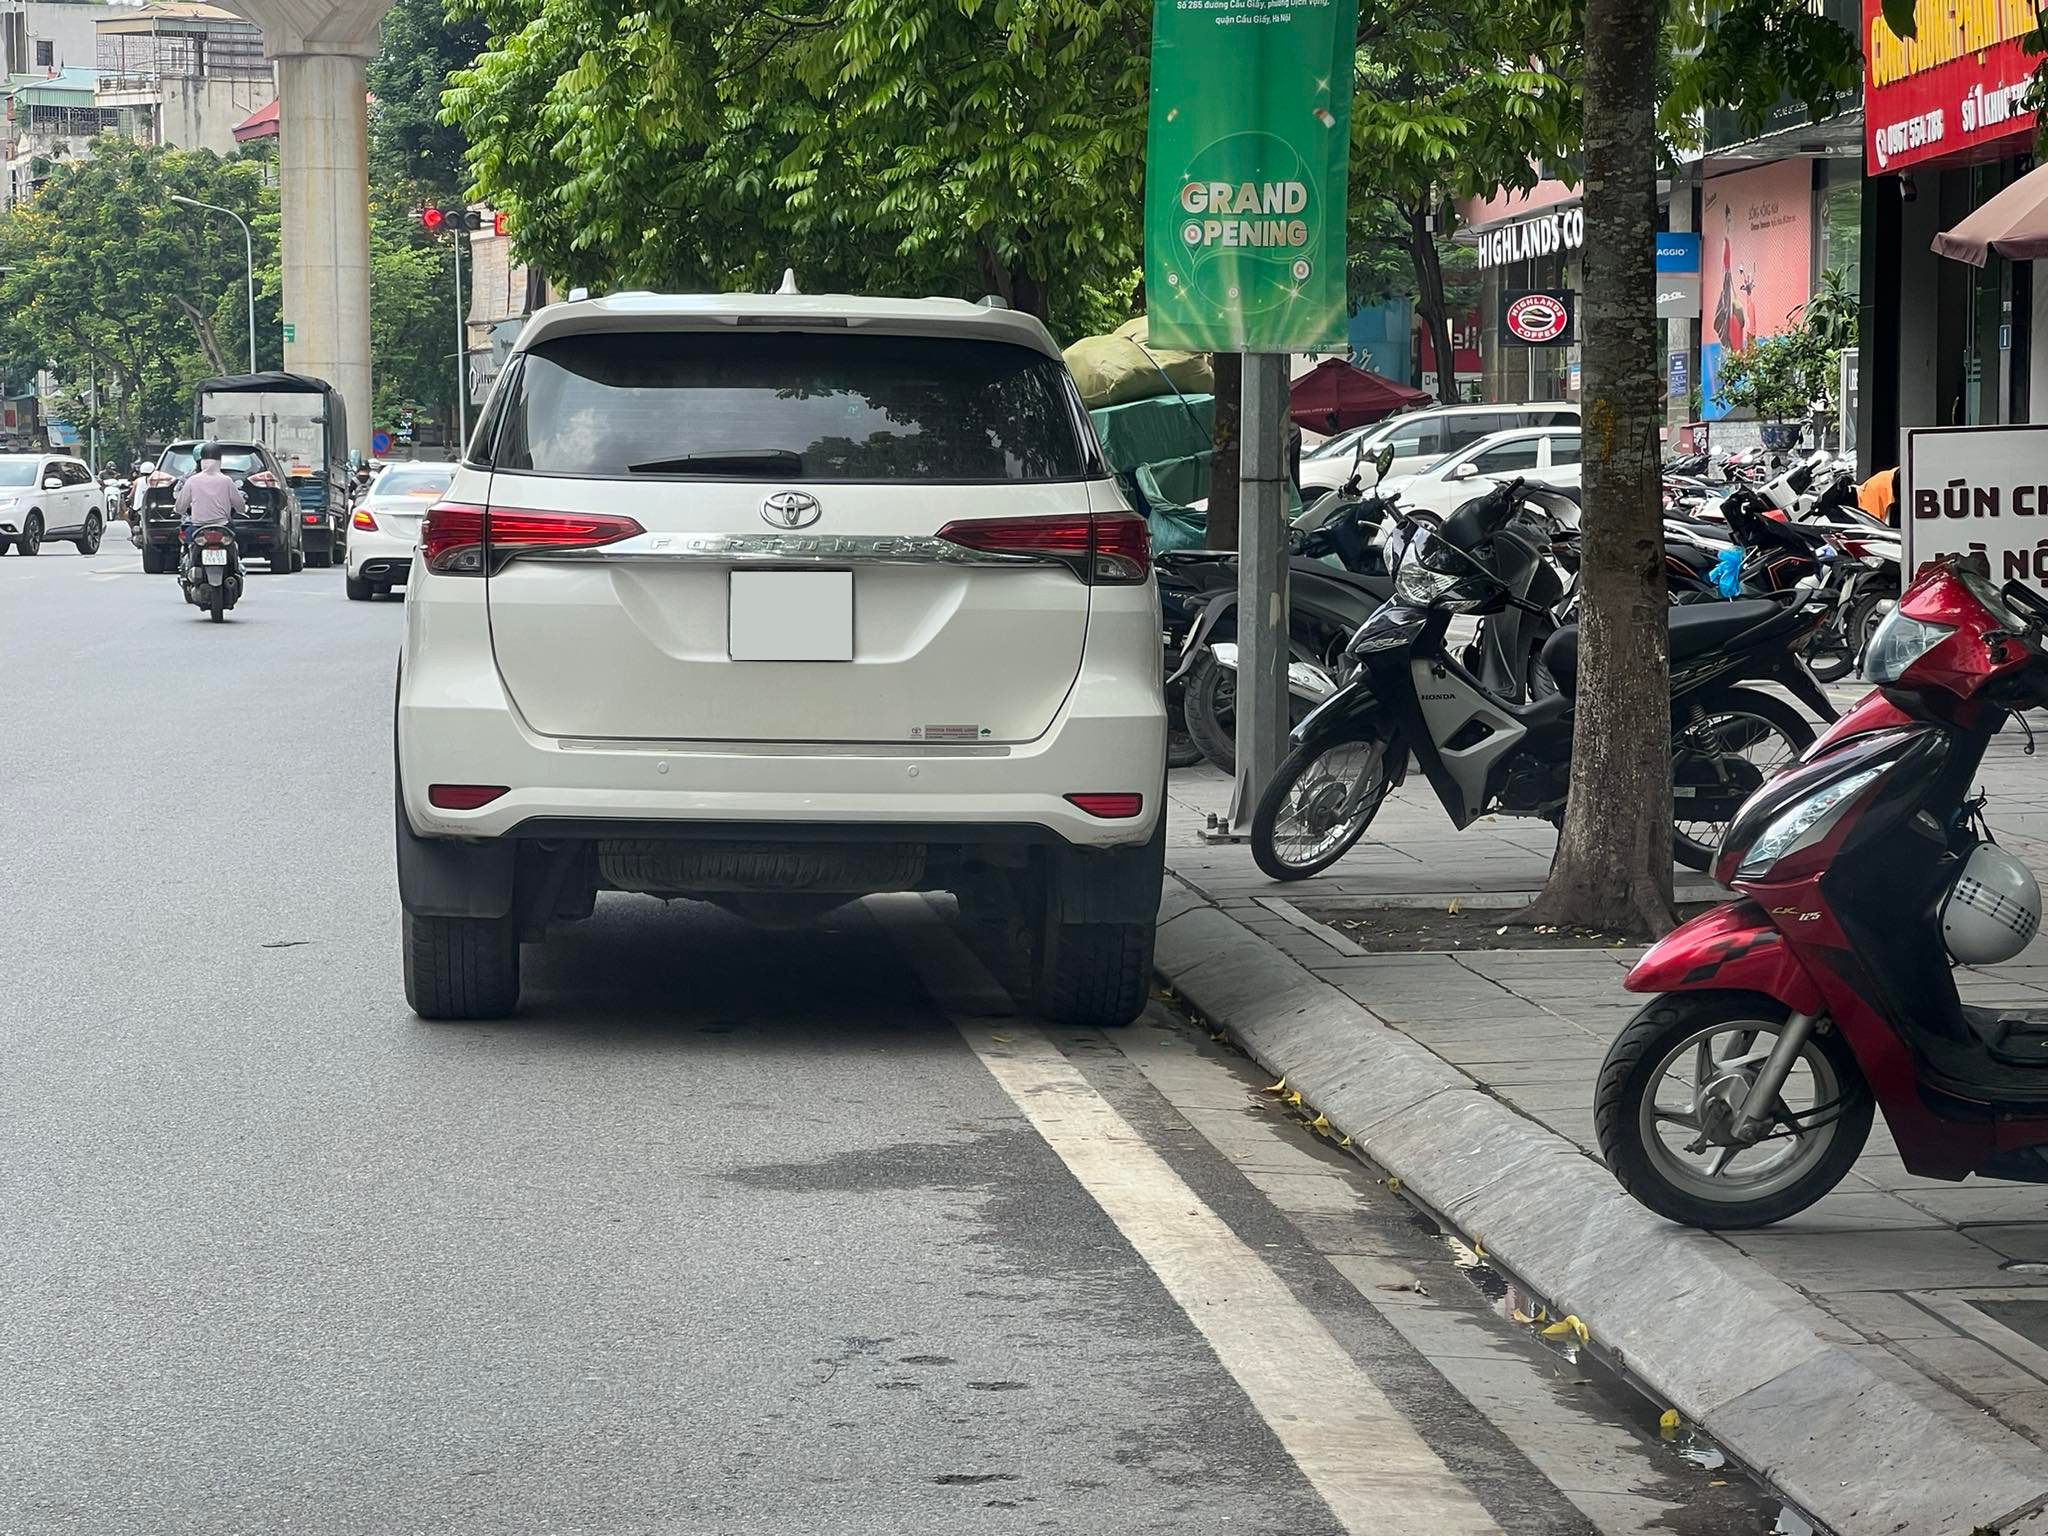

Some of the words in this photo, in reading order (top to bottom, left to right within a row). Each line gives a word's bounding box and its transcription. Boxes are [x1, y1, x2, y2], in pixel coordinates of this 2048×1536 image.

[1181, 182, 1307, 214] GRAND
[1181, 220, 1307, 247] OPENING
[1478, 214, 1560, 271] HIGHLANDS
[1511, 298, 1563, 317] HIGHLANDS
[1517, 327, 1558, 338] COFFEE
[1915, 478, 2000, 519] BÚN
[650, 536, 931, 553] FORTUNER
[1799, 911, 1822, 921] 125
